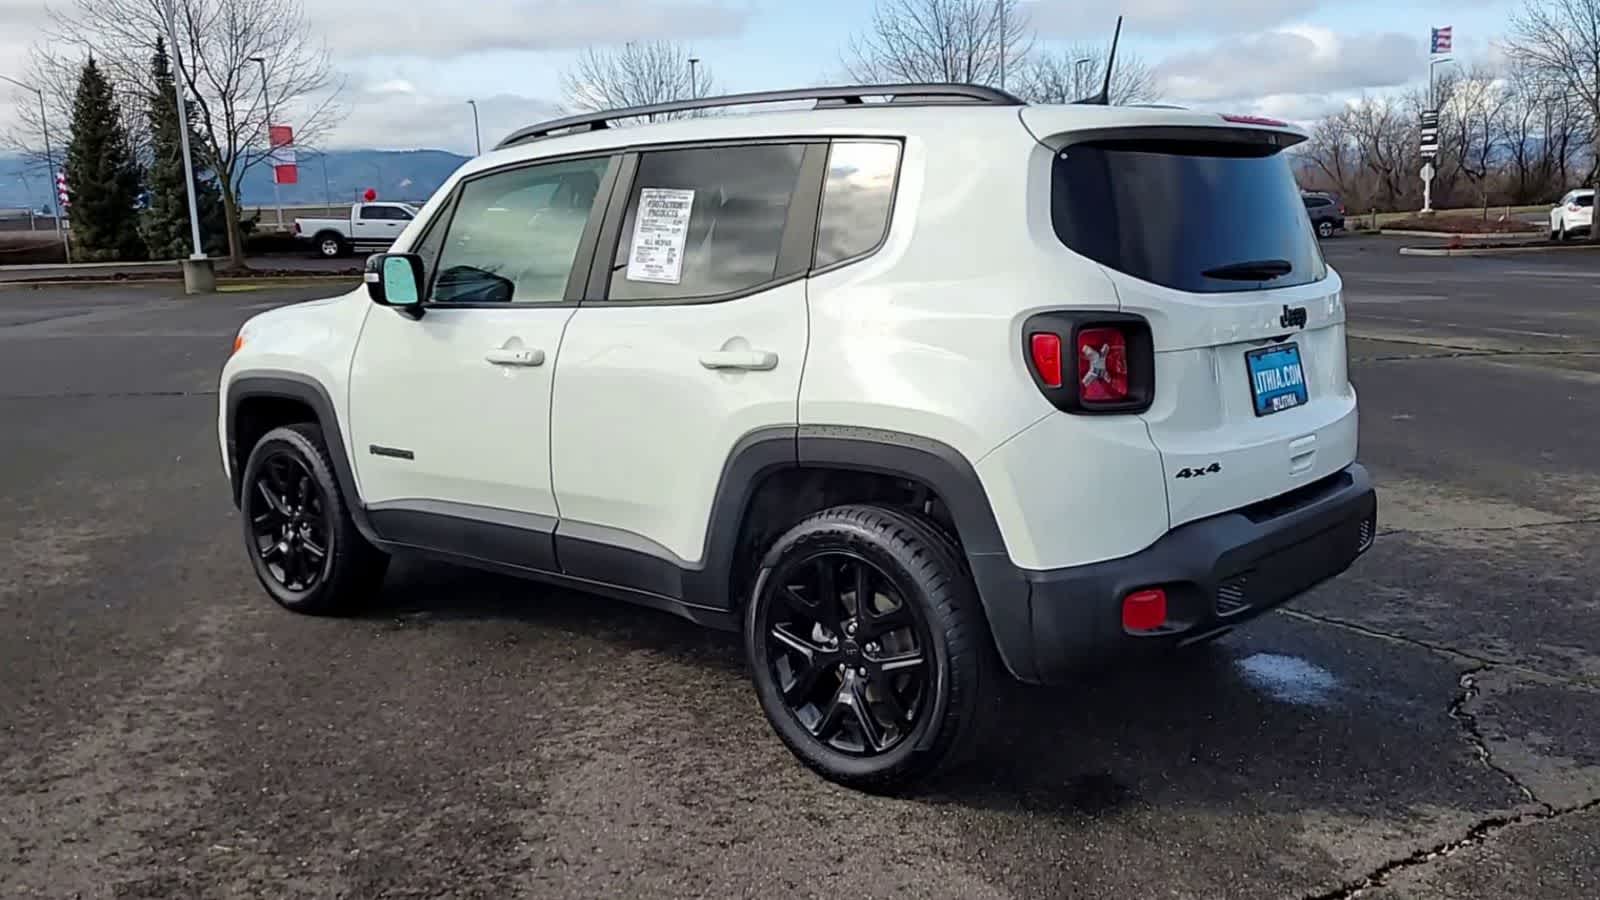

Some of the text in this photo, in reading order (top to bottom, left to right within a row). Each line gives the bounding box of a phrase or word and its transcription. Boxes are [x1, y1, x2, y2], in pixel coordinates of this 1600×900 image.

[1280, 304, 1307, 330] Jeep
[1254, 363, 1303, 395] LITHIA.COM
[1175, 462, 1222, 479] 4x4
